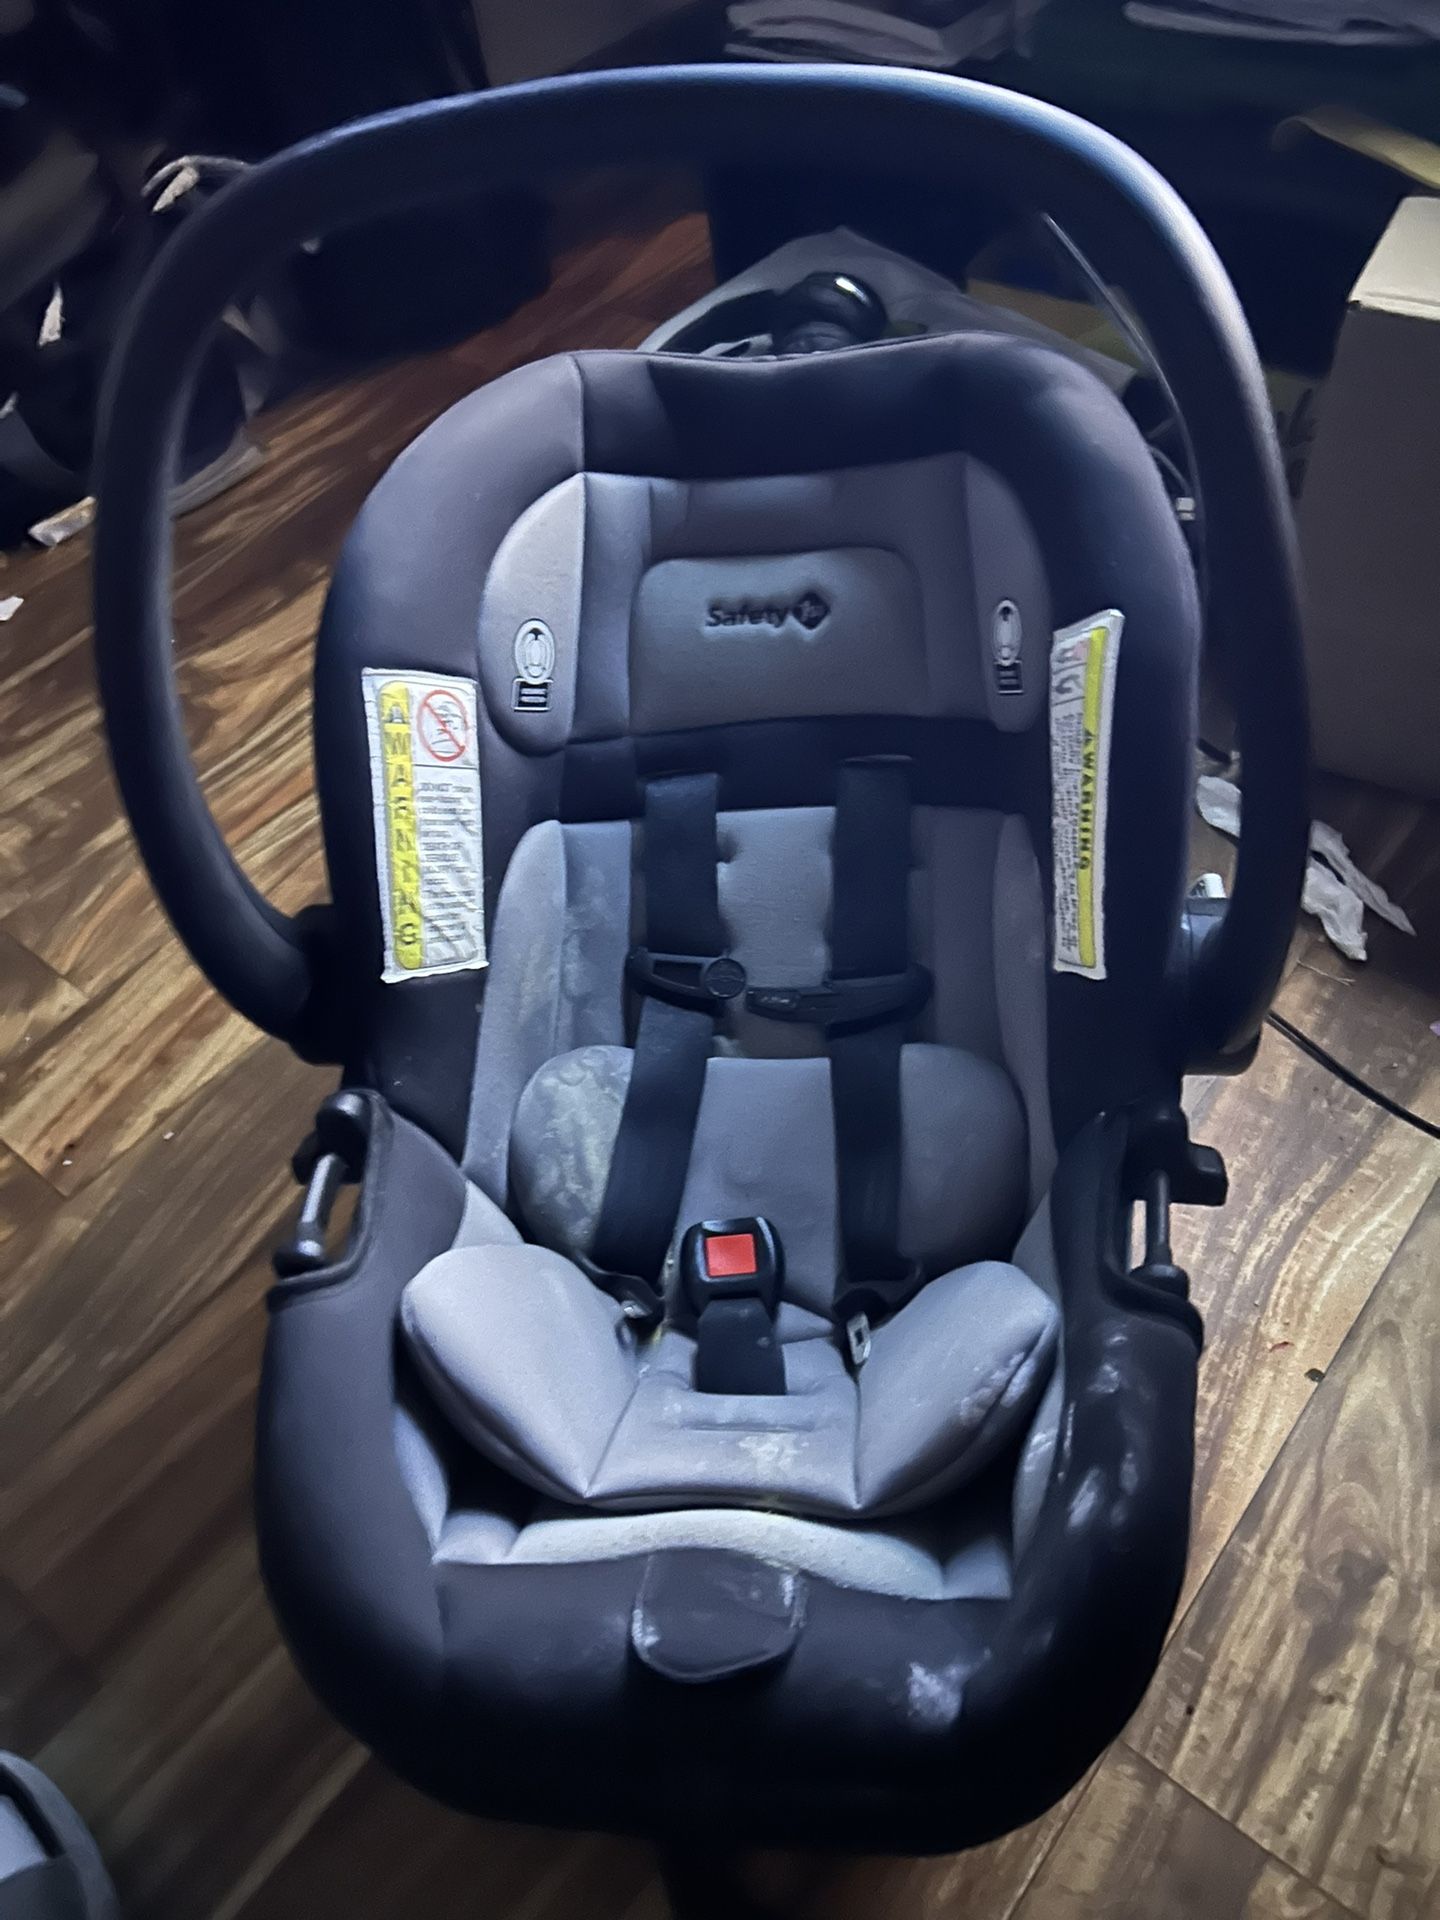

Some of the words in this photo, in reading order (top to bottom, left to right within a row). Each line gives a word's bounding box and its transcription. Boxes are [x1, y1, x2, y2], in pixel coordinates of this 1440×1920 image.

[705, 603, 788, 629] Safety
[385, 731, 417, 946] WARNING
[1080, 751, 1096, 870] WARNING
